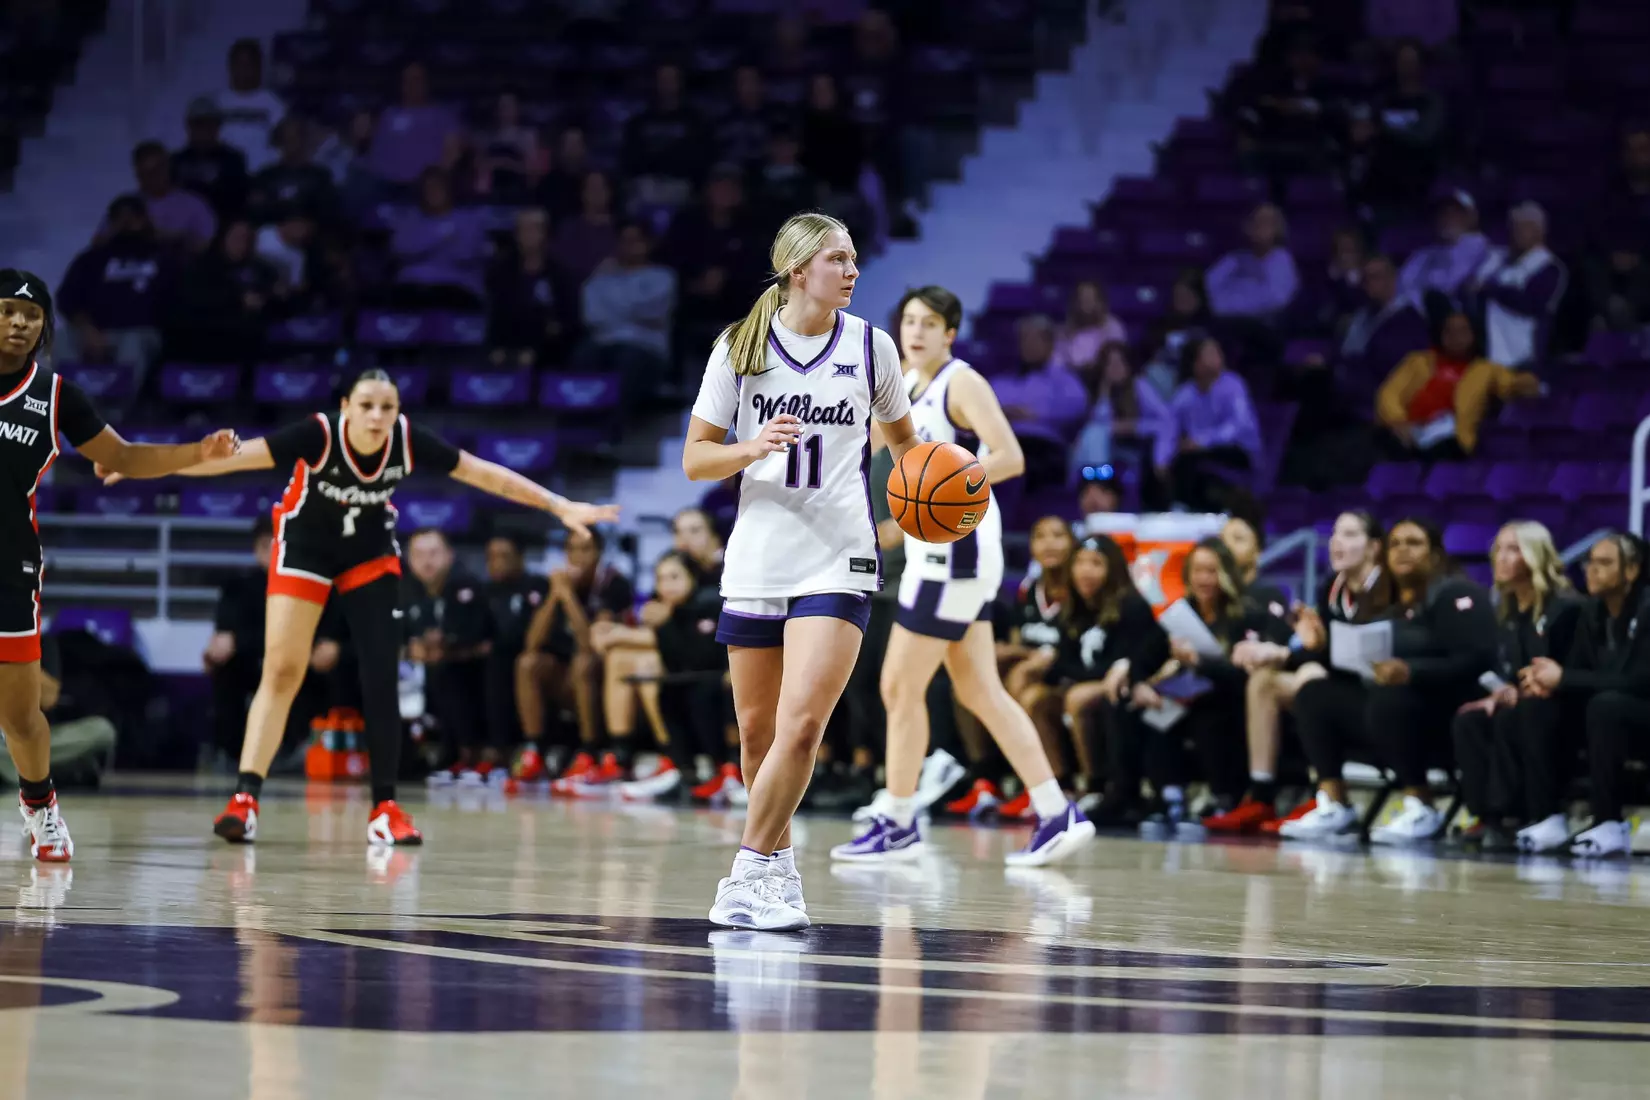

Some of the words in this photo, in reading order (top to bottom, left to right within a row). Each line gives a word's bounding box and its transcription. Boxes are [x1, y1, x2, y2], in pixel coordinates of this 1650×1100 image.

[752, 392, 855, 426] Wildcats
[0, 420, 39, 446] NATI
[785, 433, 822, 488] 11
[343, 507, 361, 537] 1
